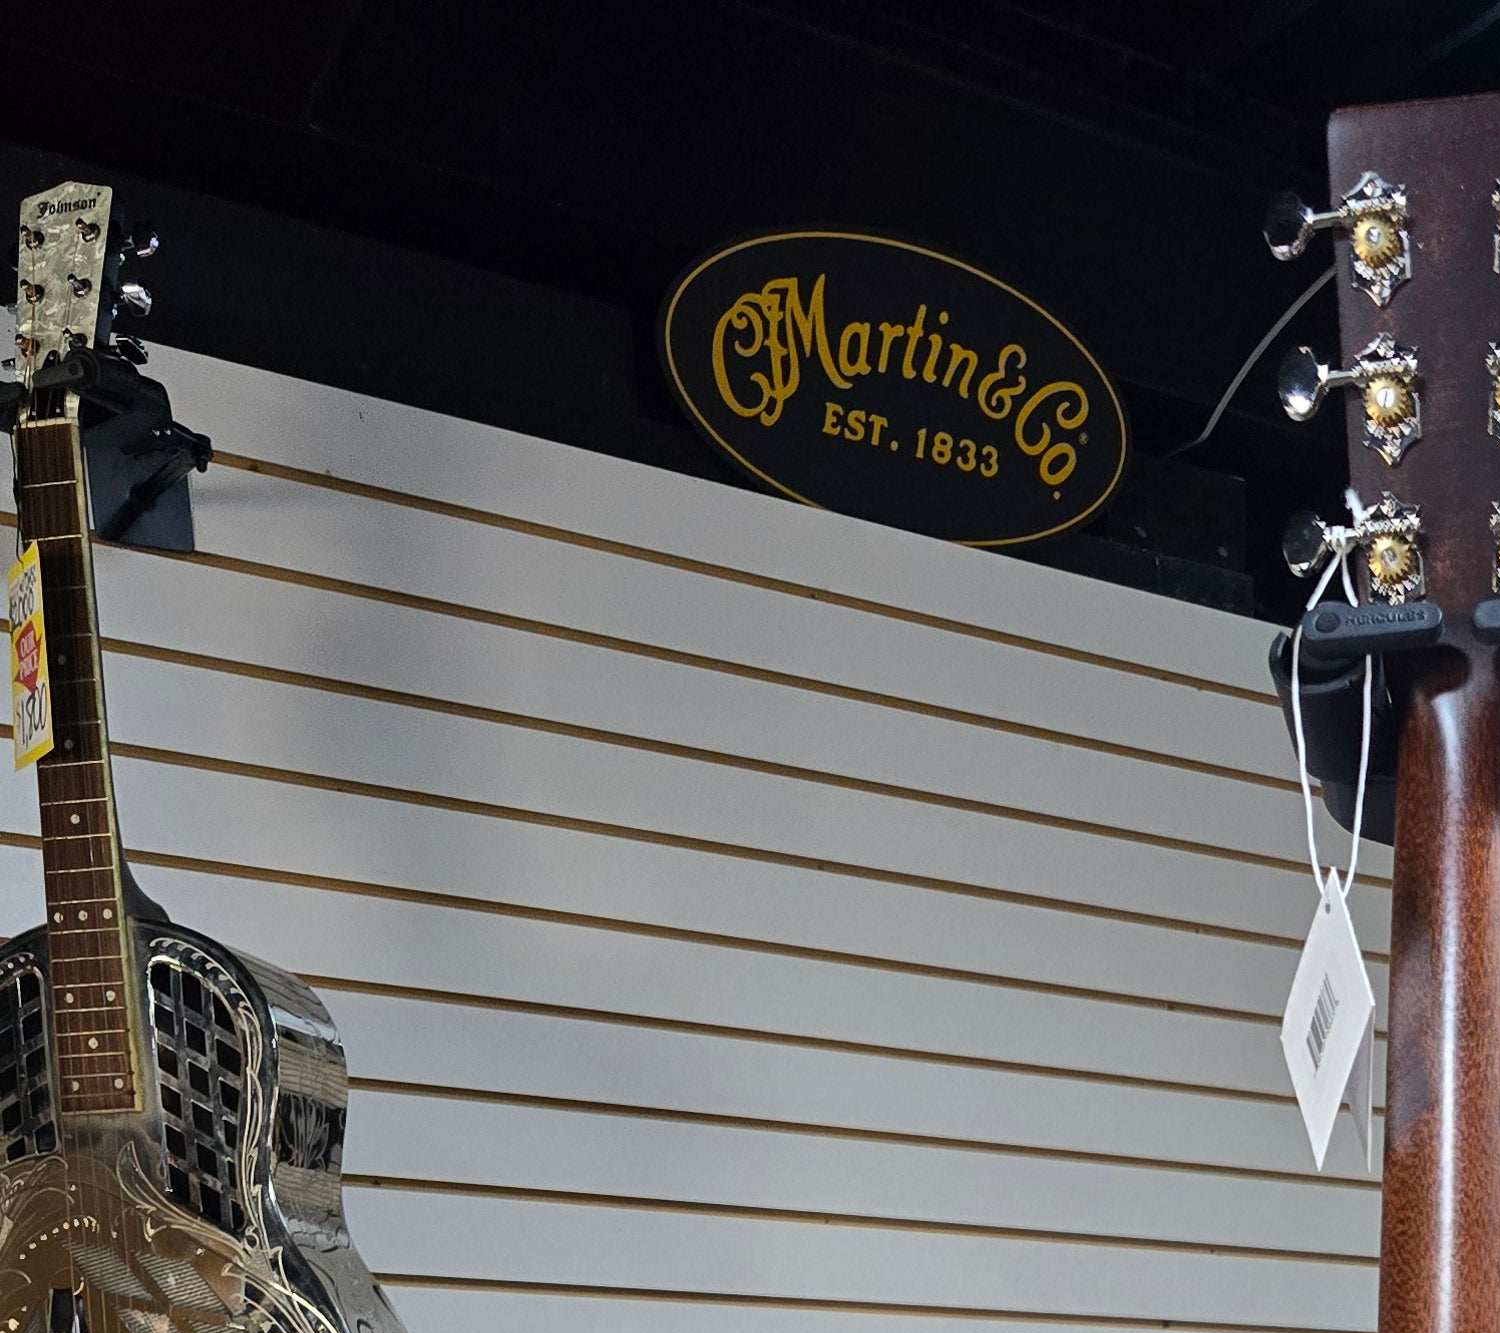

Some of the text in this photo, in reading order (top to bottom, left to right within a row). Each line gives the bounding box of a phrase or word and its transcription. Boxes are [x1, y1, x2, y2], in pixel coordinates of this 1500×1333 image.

[36, 198, 97, 220] Johnson
[822, 403, 1000, 479] EST. 1833
[20, 630, 37, 657] OUR
[20, 648, 39, 681] PRICE
